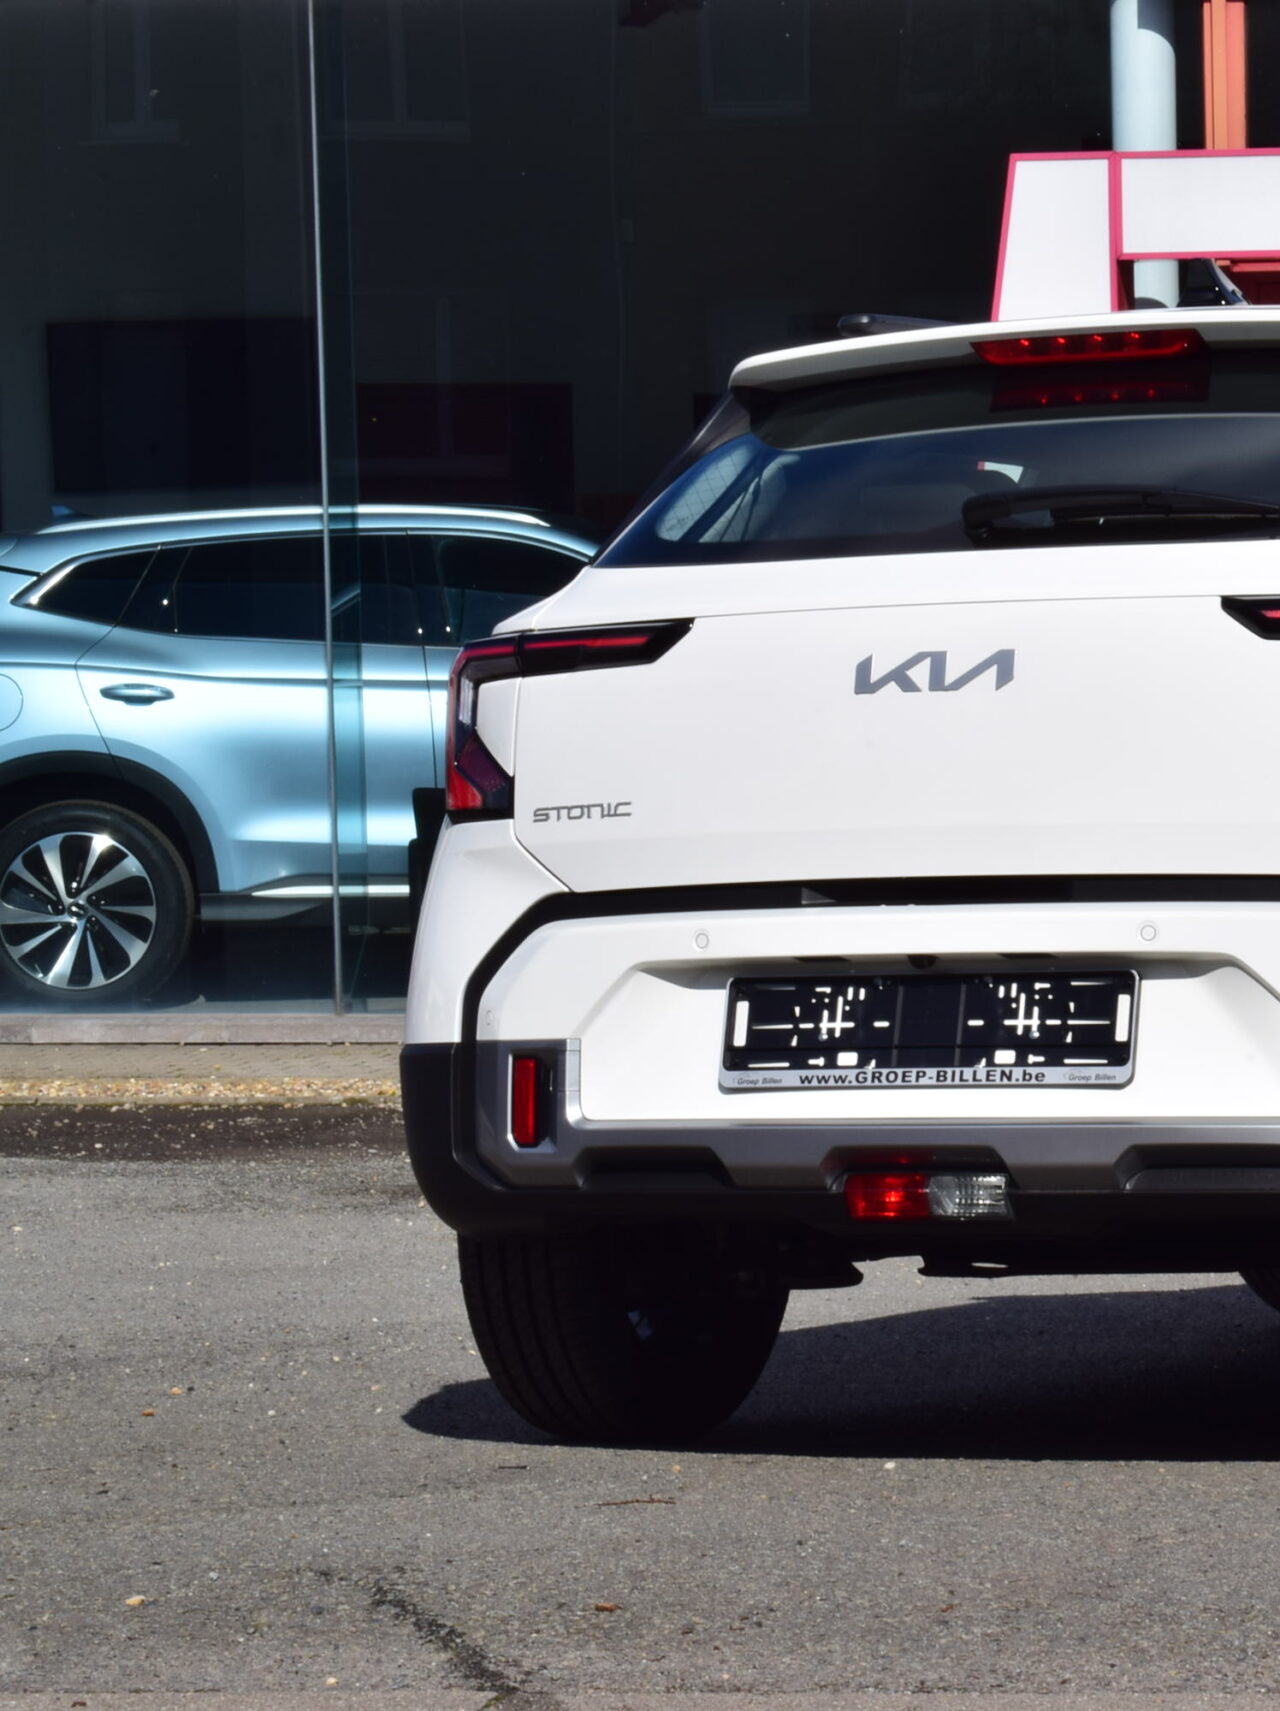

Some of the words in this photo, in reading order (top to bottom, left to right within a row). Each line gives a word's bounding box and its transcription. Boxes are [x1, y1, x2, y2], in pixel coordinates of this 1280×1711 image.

[854, 649, 1015, 694] KIA
[533, 801, 632, 823] STONIC
[737, 1077, 760, 1086] Groep
[761, 1077, 782, 1085] Billen
[799, 1069, 1046, 1085] www.GROEP-BILLEN.be
[1068, 1073, 1092, 1083] Groep
[1094, 1073, 1117, 1081] Billen
